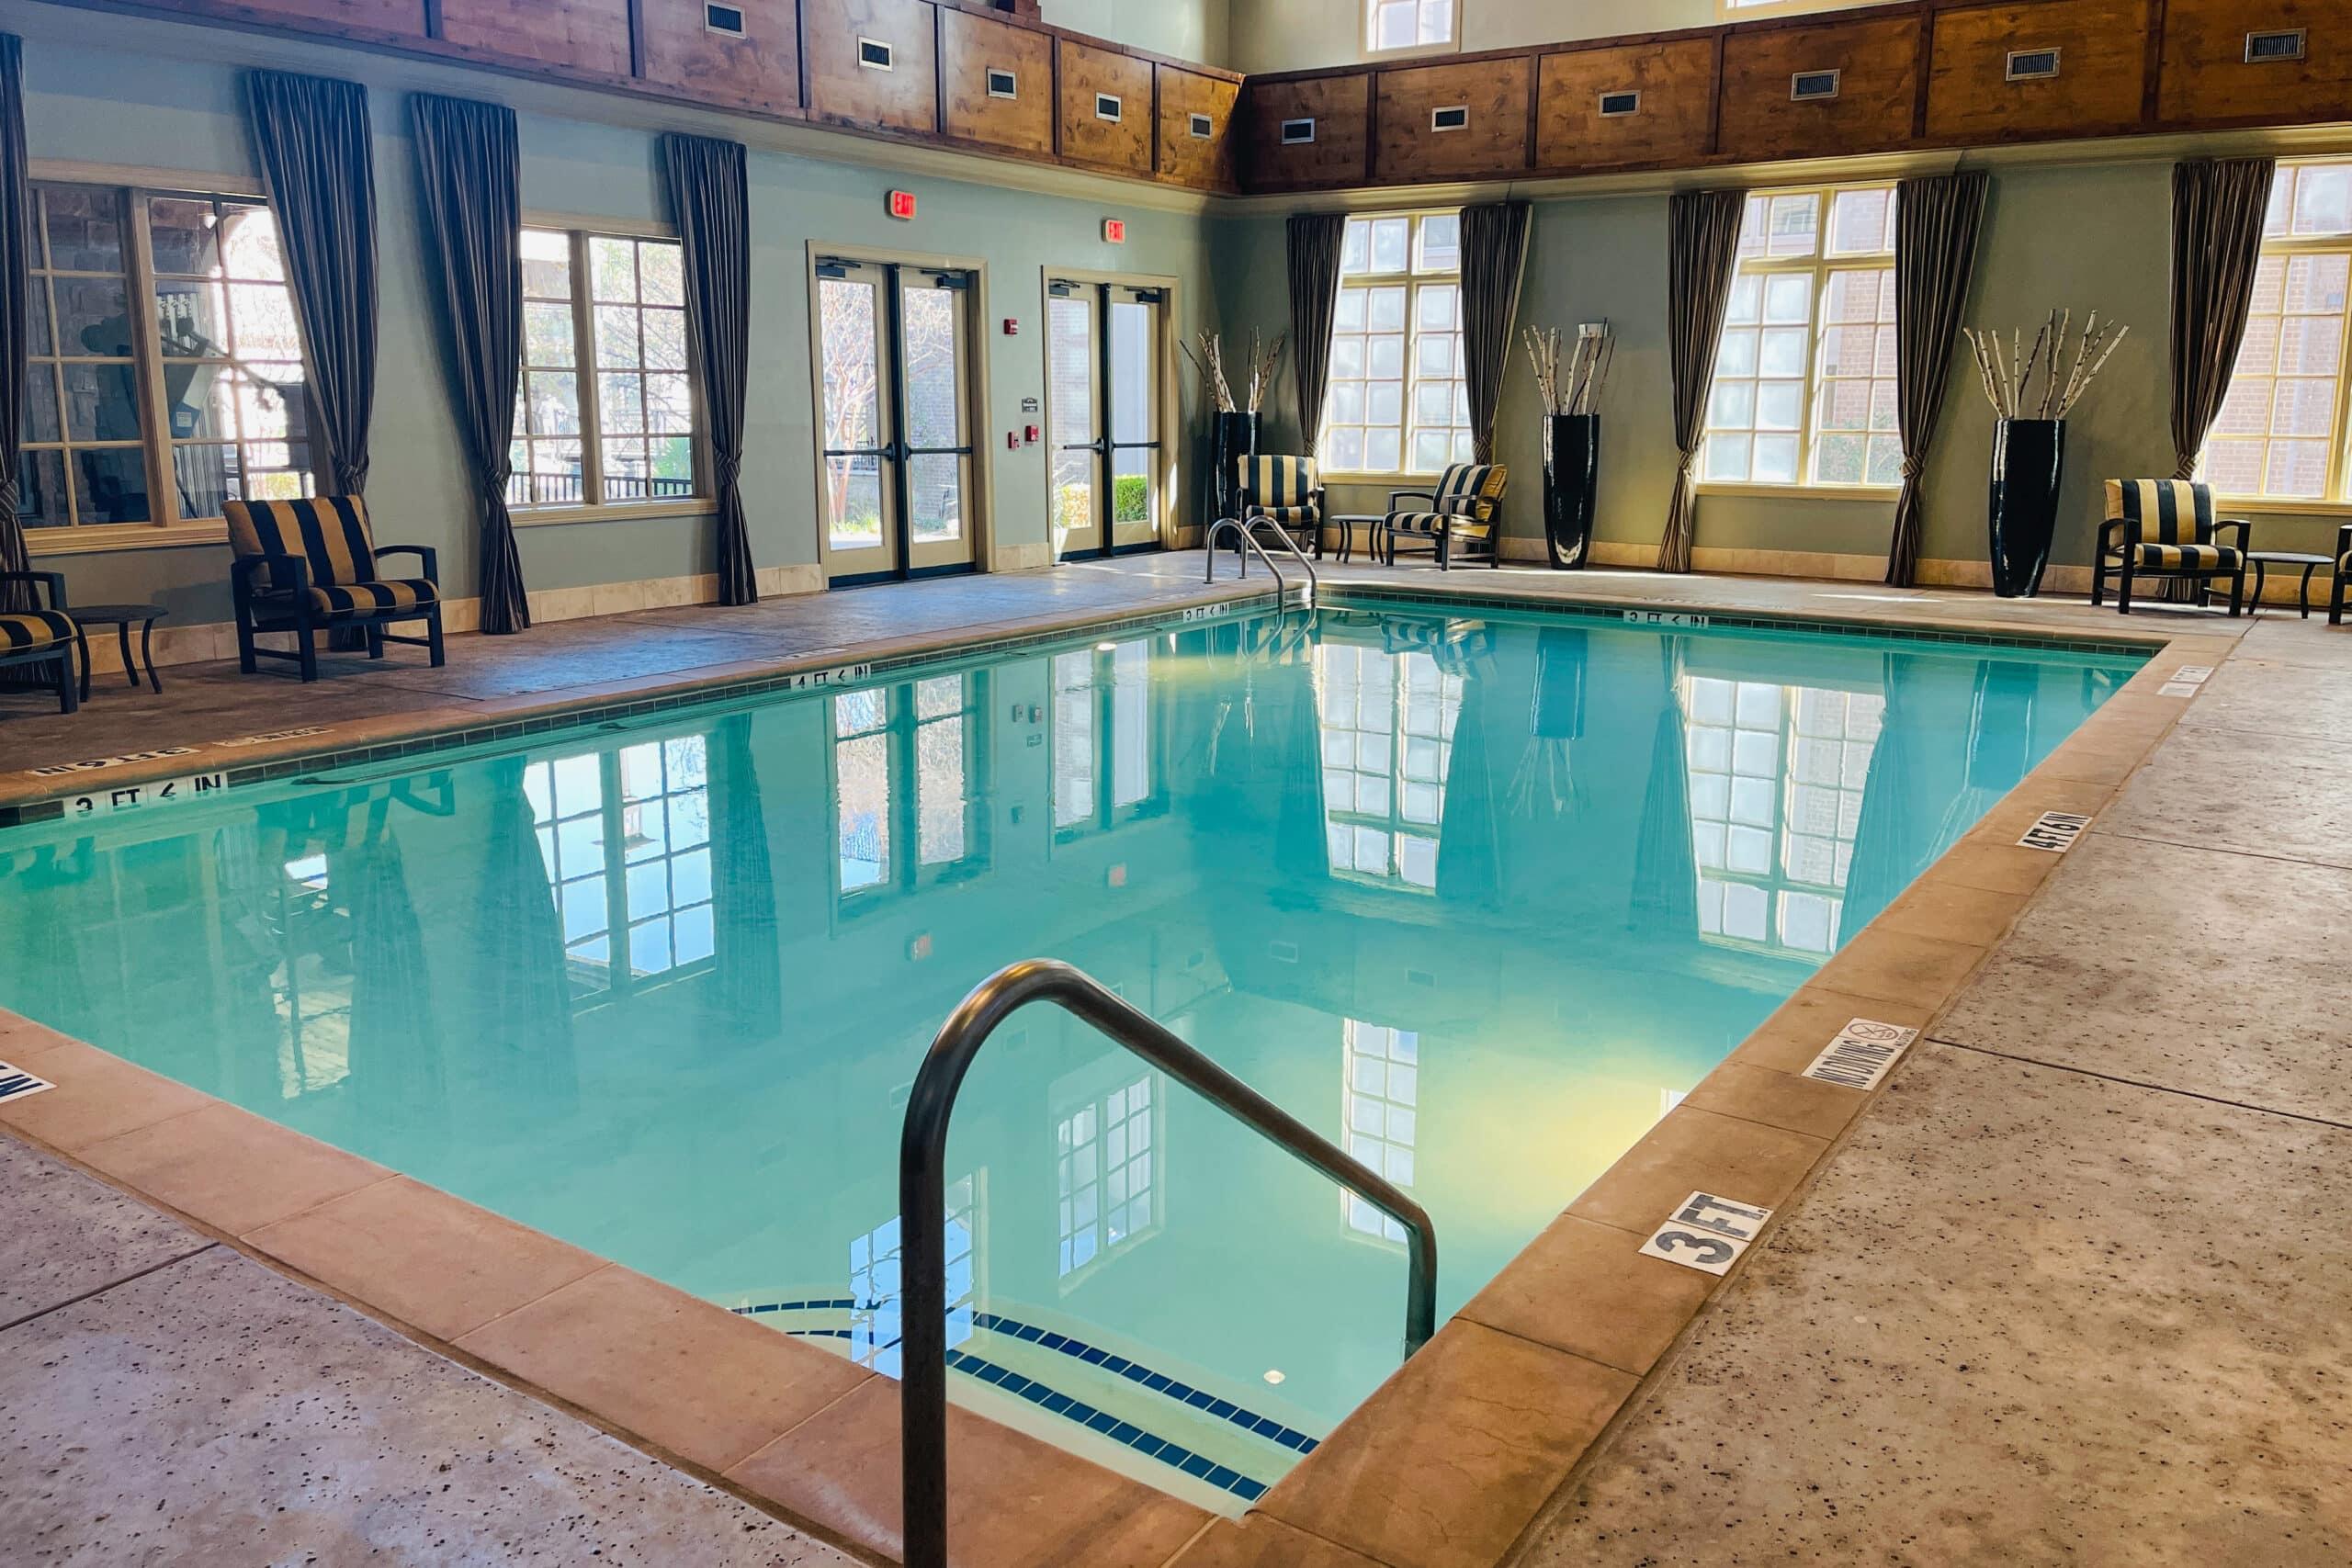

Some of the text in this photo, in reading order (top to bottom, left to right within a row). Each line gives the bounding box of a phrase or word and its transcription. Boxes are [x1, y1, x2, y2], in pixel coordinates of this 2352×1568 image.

[35, 765, 76, 775] IN
[195, 774, 220, 792] IN
[1810, 1040, 1894, 1088] NO DIVING
[1656, 1231, 1734, 1264] 3
